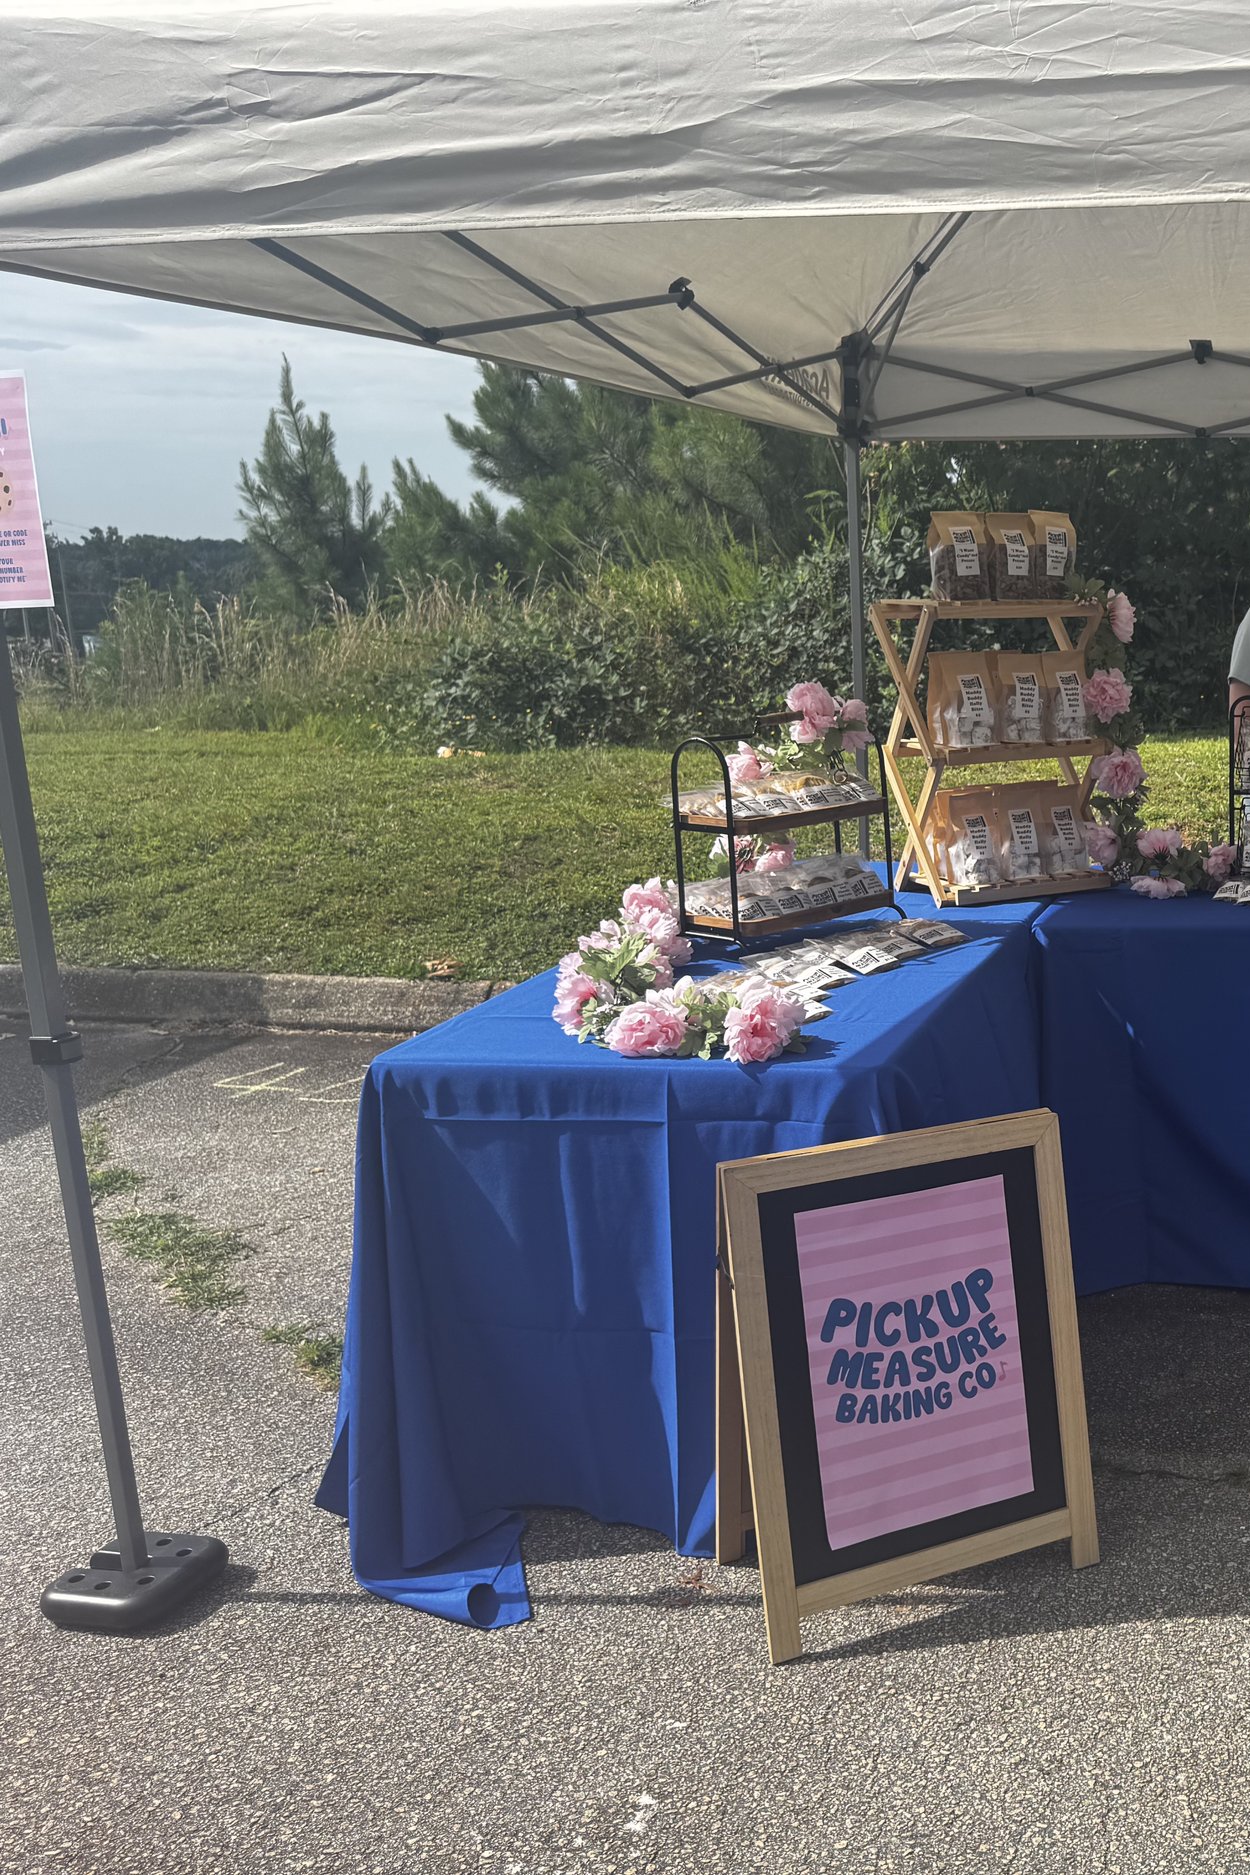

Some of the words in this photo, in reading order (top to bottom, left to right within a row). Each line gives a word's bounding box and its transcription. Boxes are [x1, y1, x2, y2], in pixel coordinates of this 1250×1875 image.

[12, 529, 28, 537] CODE
[820, 1268, 994, 1348] PICKUP
[827, 1312, 1007, 1390] MEASURE
[835, 1381, 952, 1424] BAKING
[958, 1362, 996, 1399] CO
